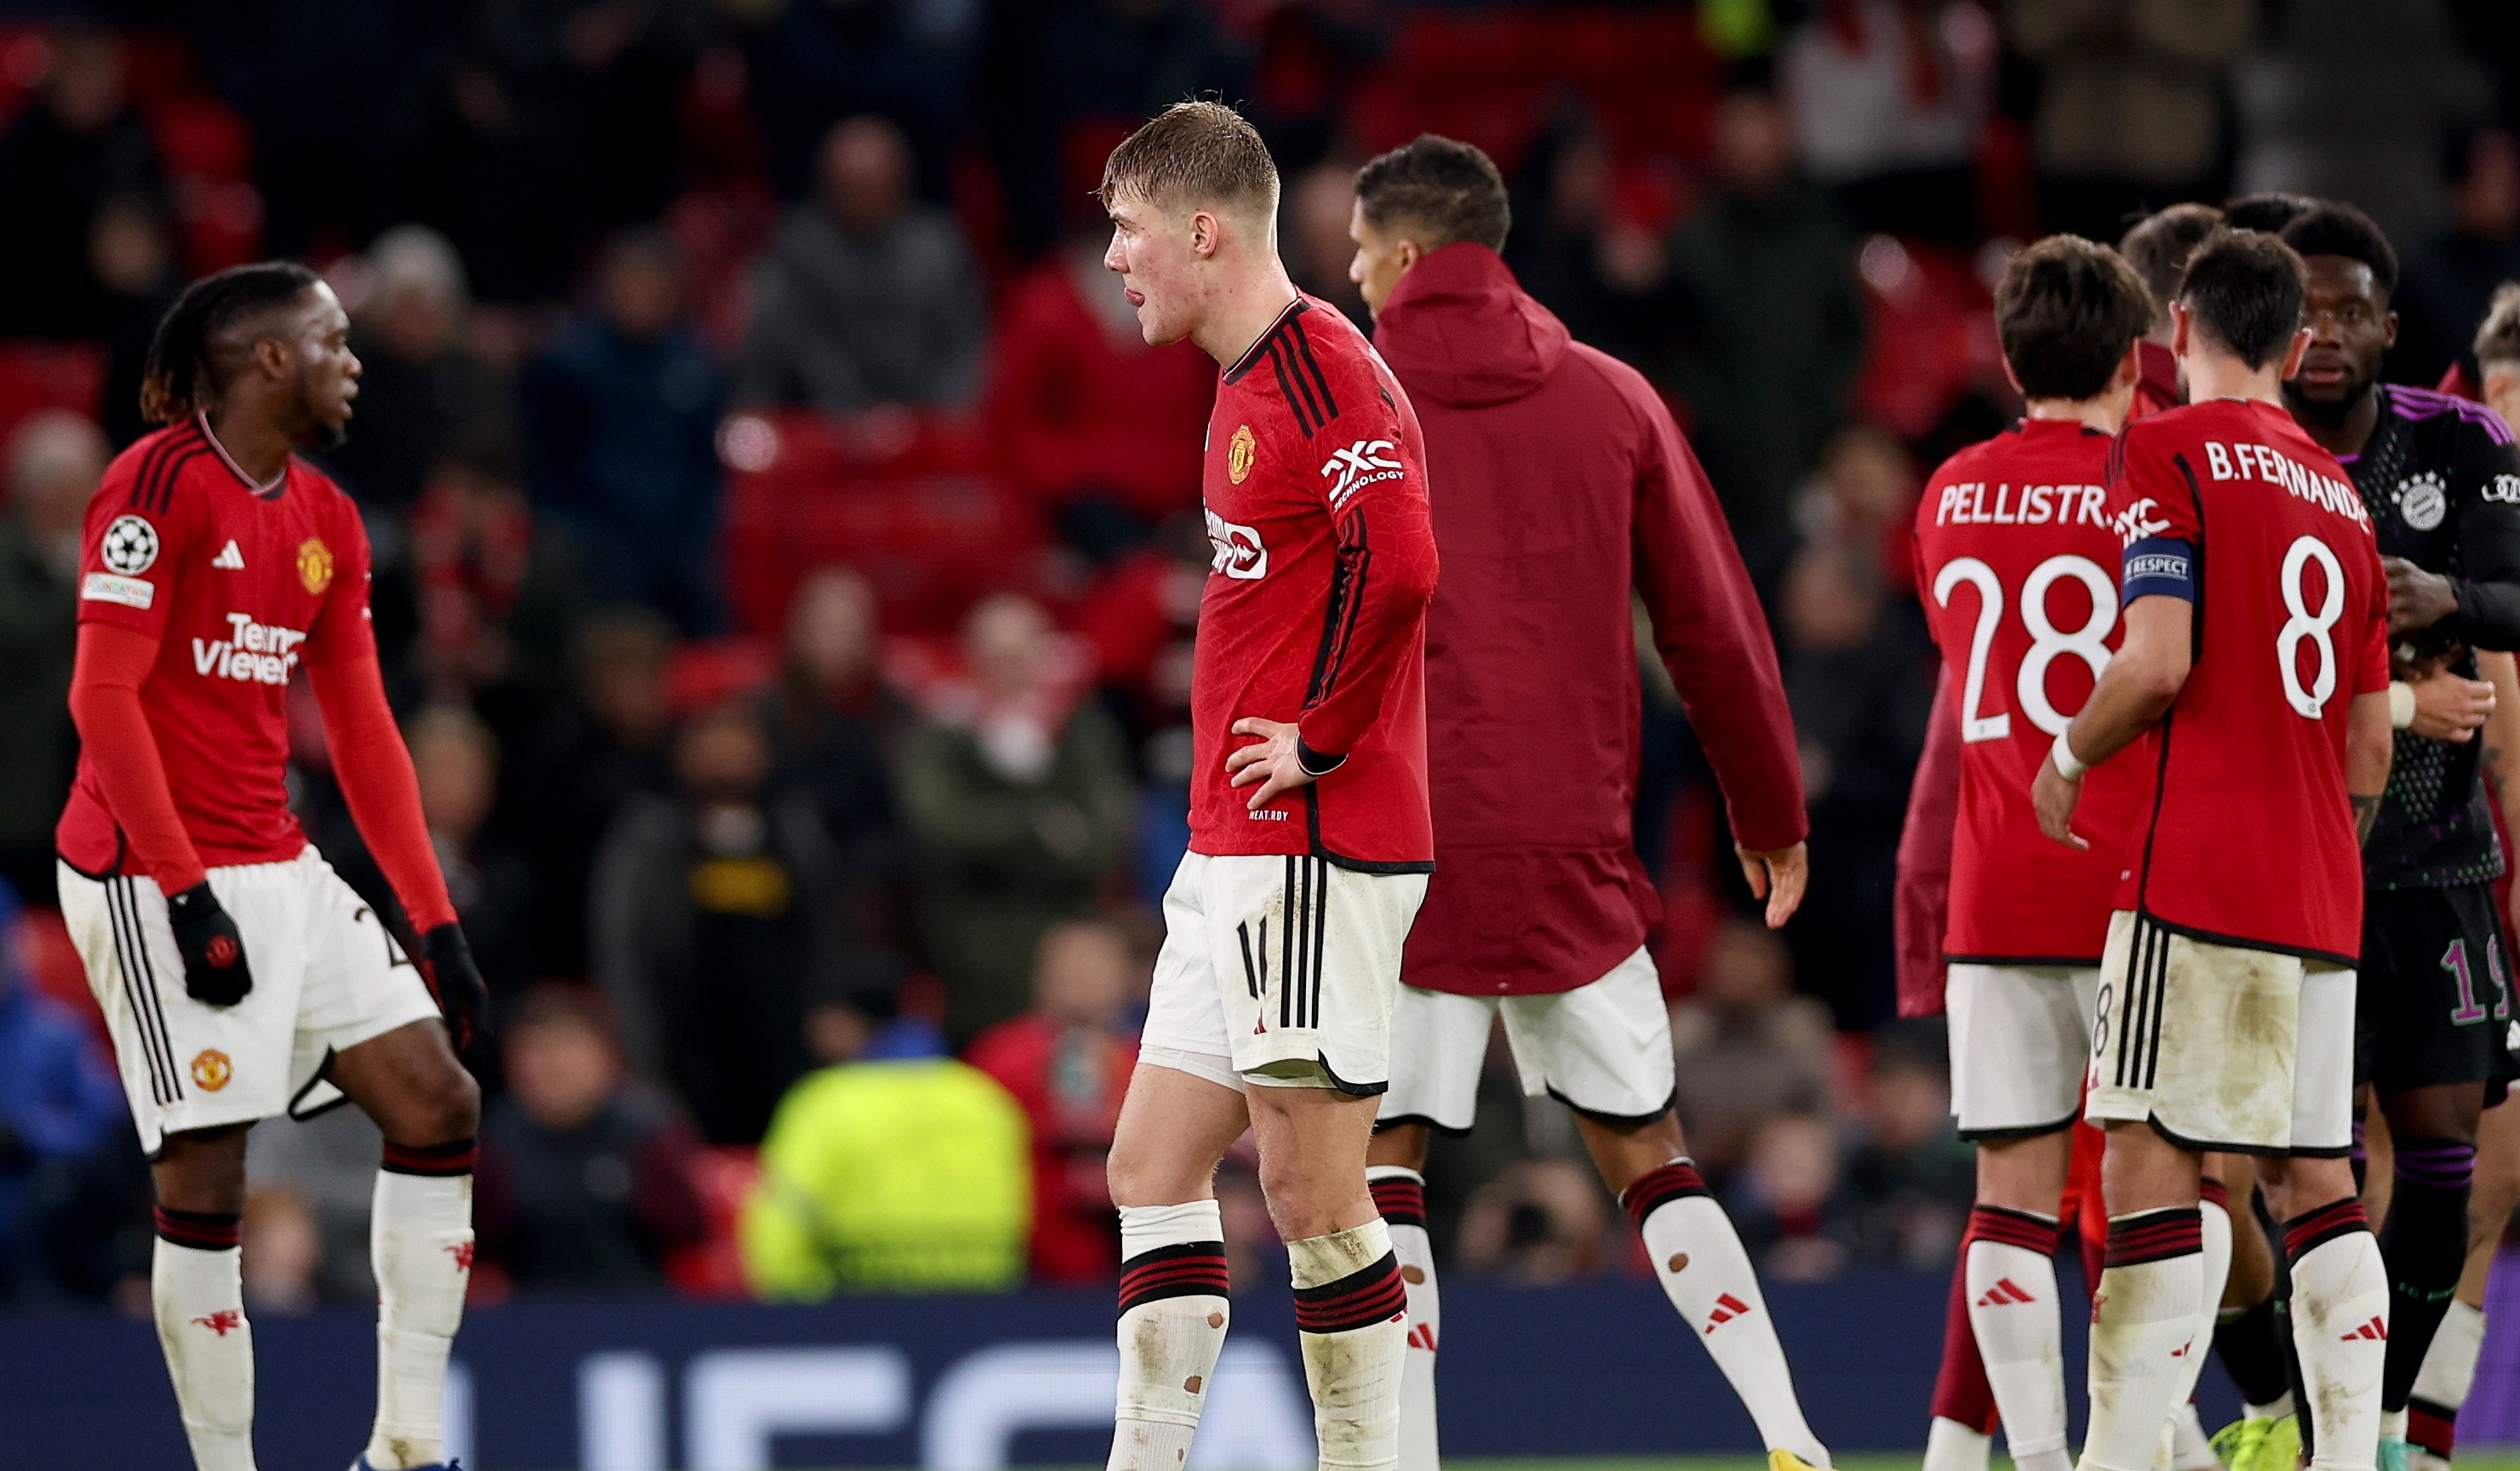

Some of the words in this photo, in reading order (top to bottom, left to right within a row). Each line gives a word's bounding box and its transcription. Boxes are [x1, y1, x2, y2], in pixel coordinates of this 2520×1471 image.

[1320, 440, 1403, 502] DXC
[1334, 471, 1404, 512] TECHNOLOGY
[1935, 482, 2113, 529] PELLISTR
[2133, 558, 2188, 575] RESPECT
[226, 611, 307, 655] Tem
[1933, 554, 2119, 743] 28
[2276, 535, 2345, 719] 8
[1248, 810, 1289, 821] HEAT.RDY
[1236, 913, 1268, 1000] 11
[2093, 982, 2113, 1058] 8
